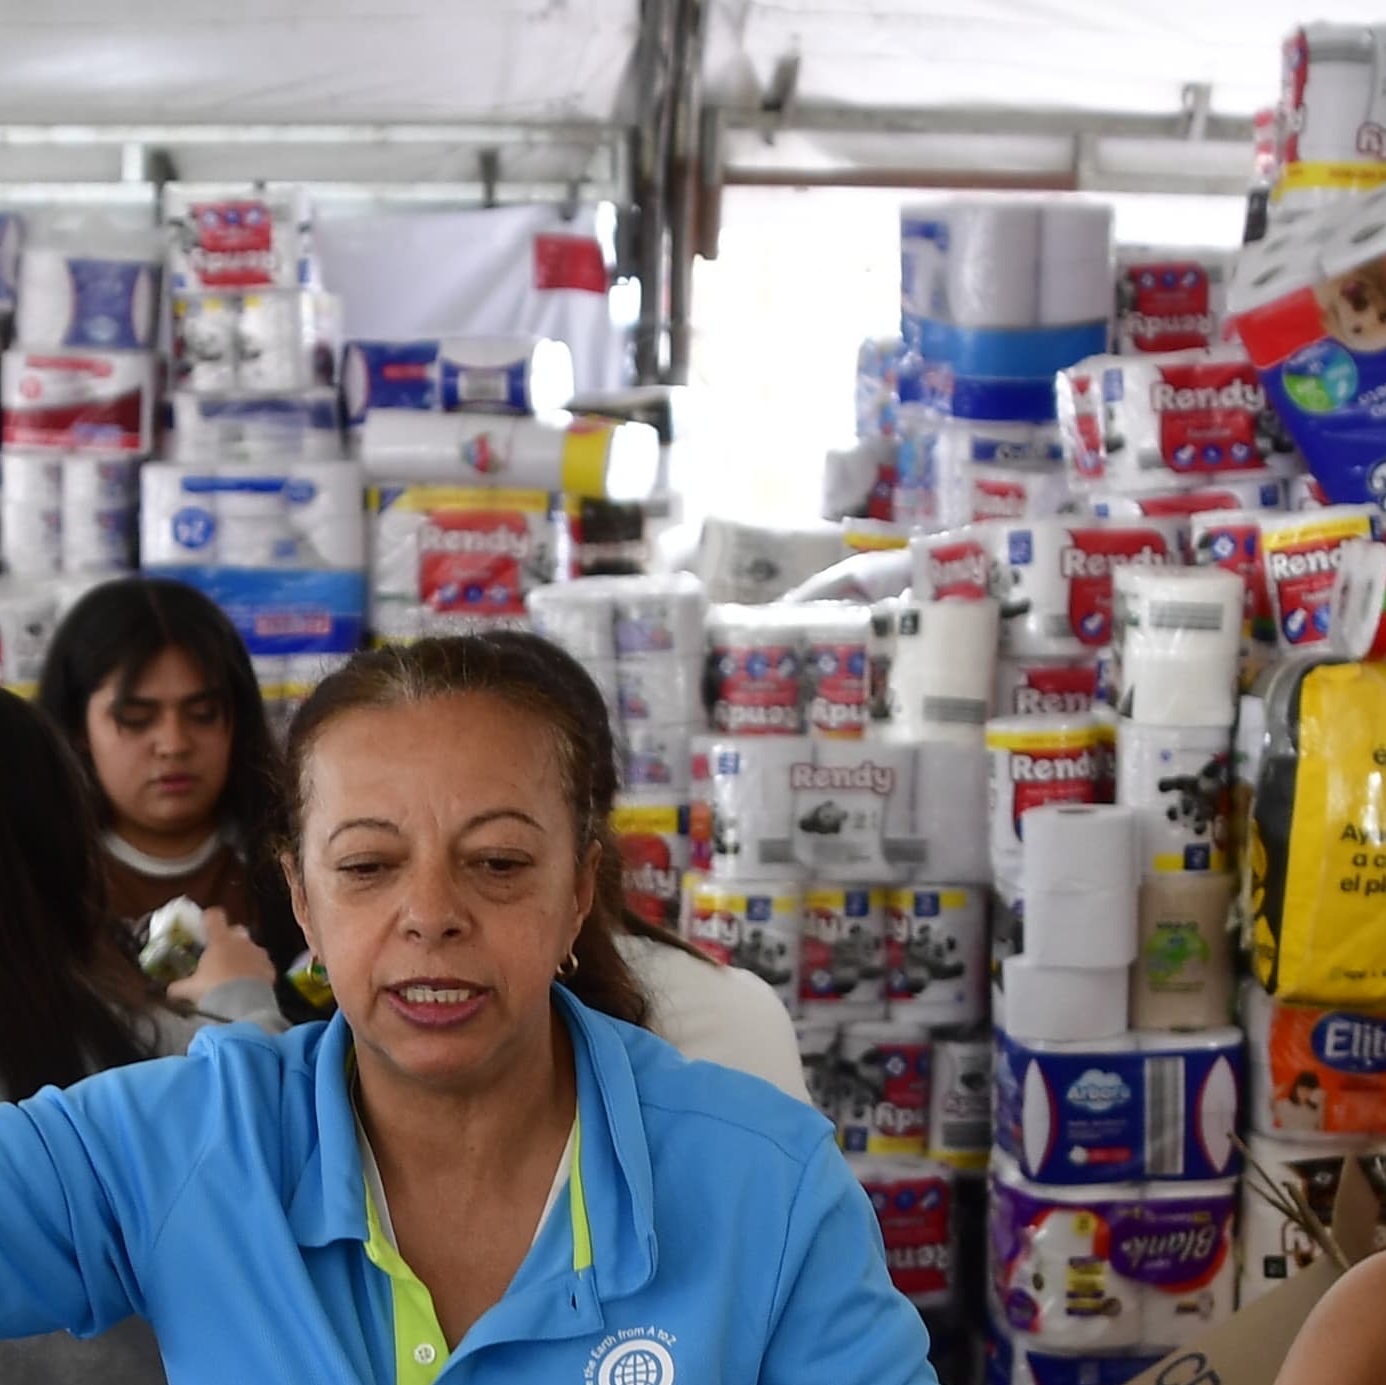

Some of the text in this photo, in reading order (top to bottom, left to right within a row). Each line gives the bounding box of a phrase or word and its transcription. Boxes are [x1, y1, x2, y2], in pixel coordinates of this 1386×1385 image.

[1153, 380, 1265, 413] Rendy
[1270, 541, 1343, 580] Rend
[791, 763, 898, 790] Rendy
[1340, 876, 1359, 892] el
[617, 1327, 644, 1341] from
